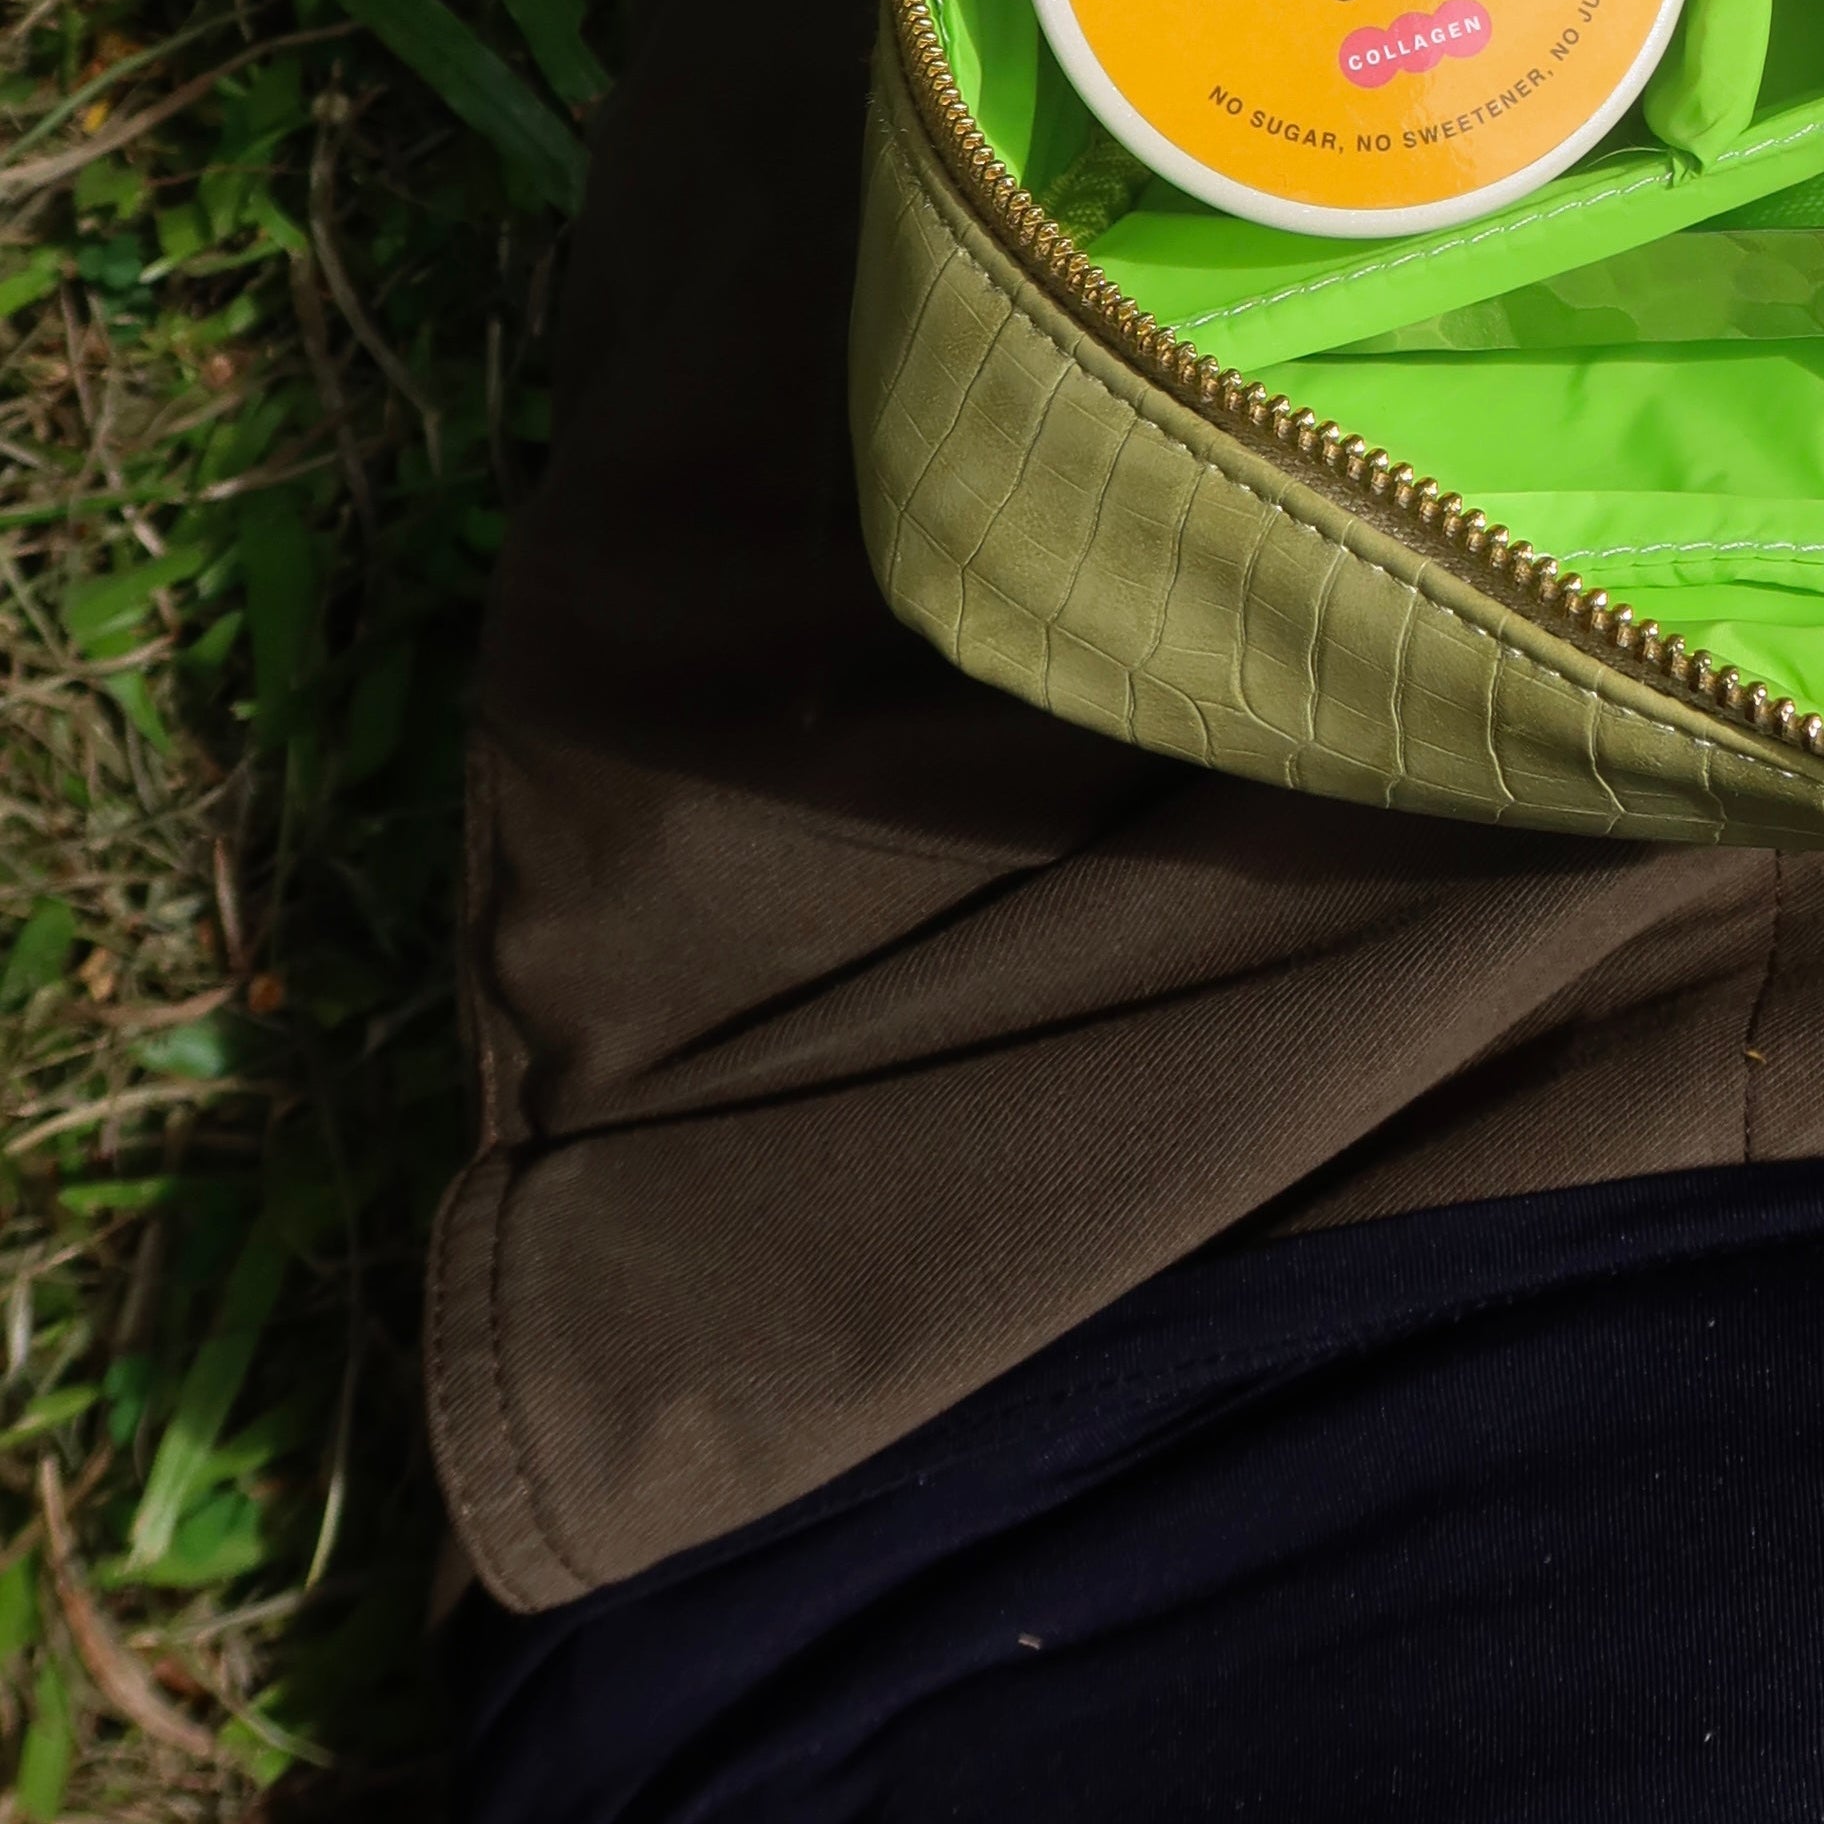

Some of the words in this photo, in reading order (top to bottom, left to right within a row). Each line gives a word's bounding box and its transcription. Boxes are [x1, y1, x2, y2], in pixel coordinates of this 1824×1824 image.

[1347, 14, 1482, 71] COLLAGEN
[1208, 85, 1244, 116] NO
[1249, 109, 1344, 153] SUGAR,
[1357, 134, 1391, 152] NO
[1403, 69, 1555, 149] SWEETENER,
[1548, 26, 1581, 63] NO
